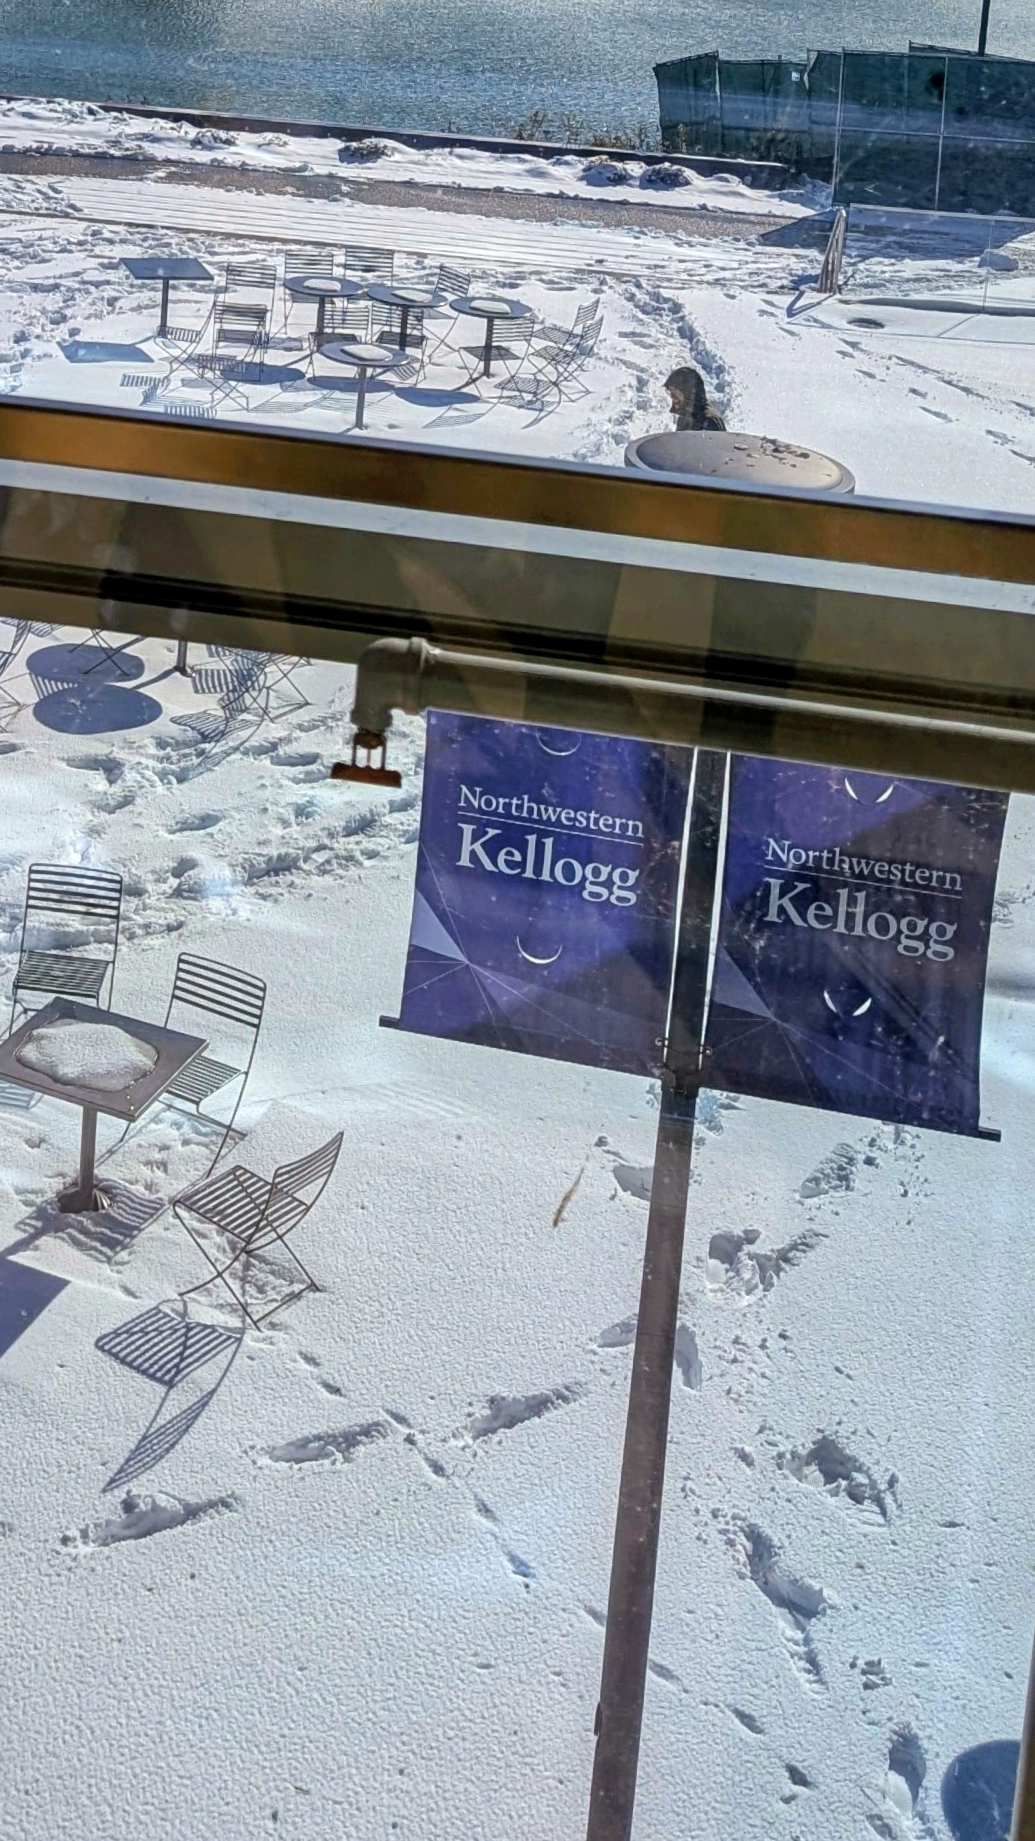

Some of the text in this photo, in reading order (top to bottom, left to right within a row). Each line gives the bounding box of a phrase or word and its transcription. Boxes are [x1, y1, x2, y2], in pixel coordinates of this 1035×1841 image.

[459, 785, 644, 838] Northwestern
[456, 823, 640, 907] Kellogg
[766, 839, 962, 892] Northwestern
[764, 878, 958, 962] Kellogg
